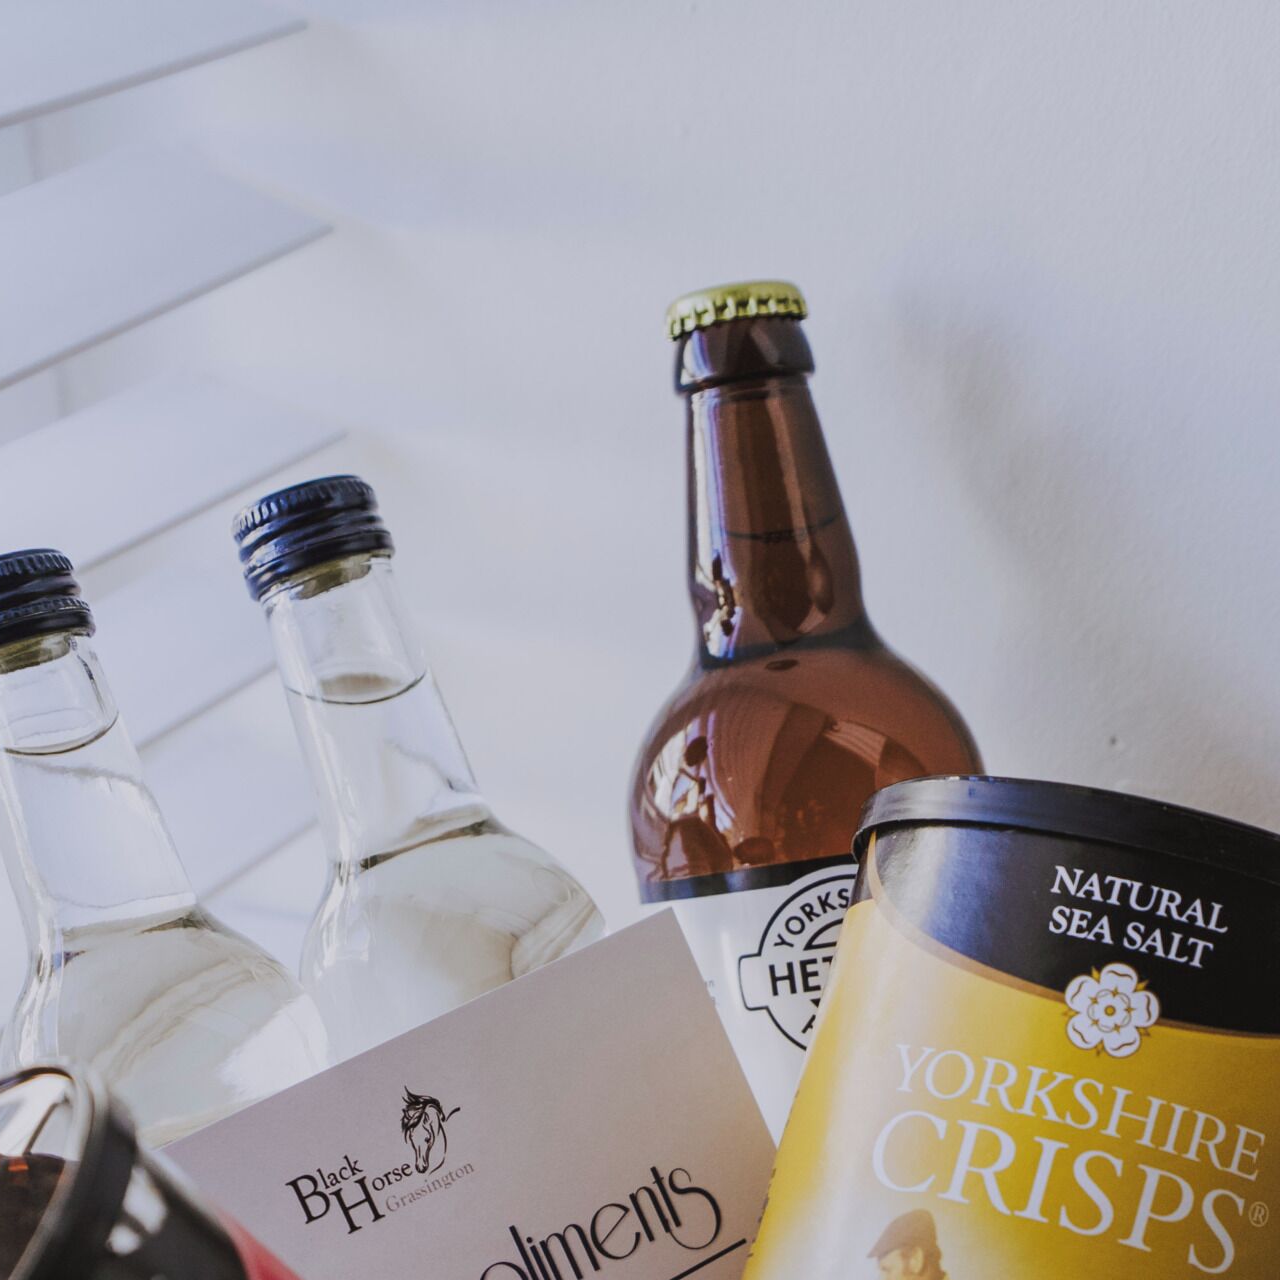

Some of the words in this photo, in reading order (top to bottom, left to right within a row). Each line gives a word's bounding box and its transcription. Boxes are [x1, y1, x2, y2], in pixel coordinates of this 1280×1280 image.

[1050, 865, 1228, 933] NATURAL
[1048, 905, 1113, 945] SEA
[1123, 920, 1214, 968] SALT
[896, 1043, 1266, 1181] YORKSHIRE
[285, 1155, 363, 1224] Black
[329, 1163, 413, 1234] Horse
[386, 1162, 474, 1212] Grassington
